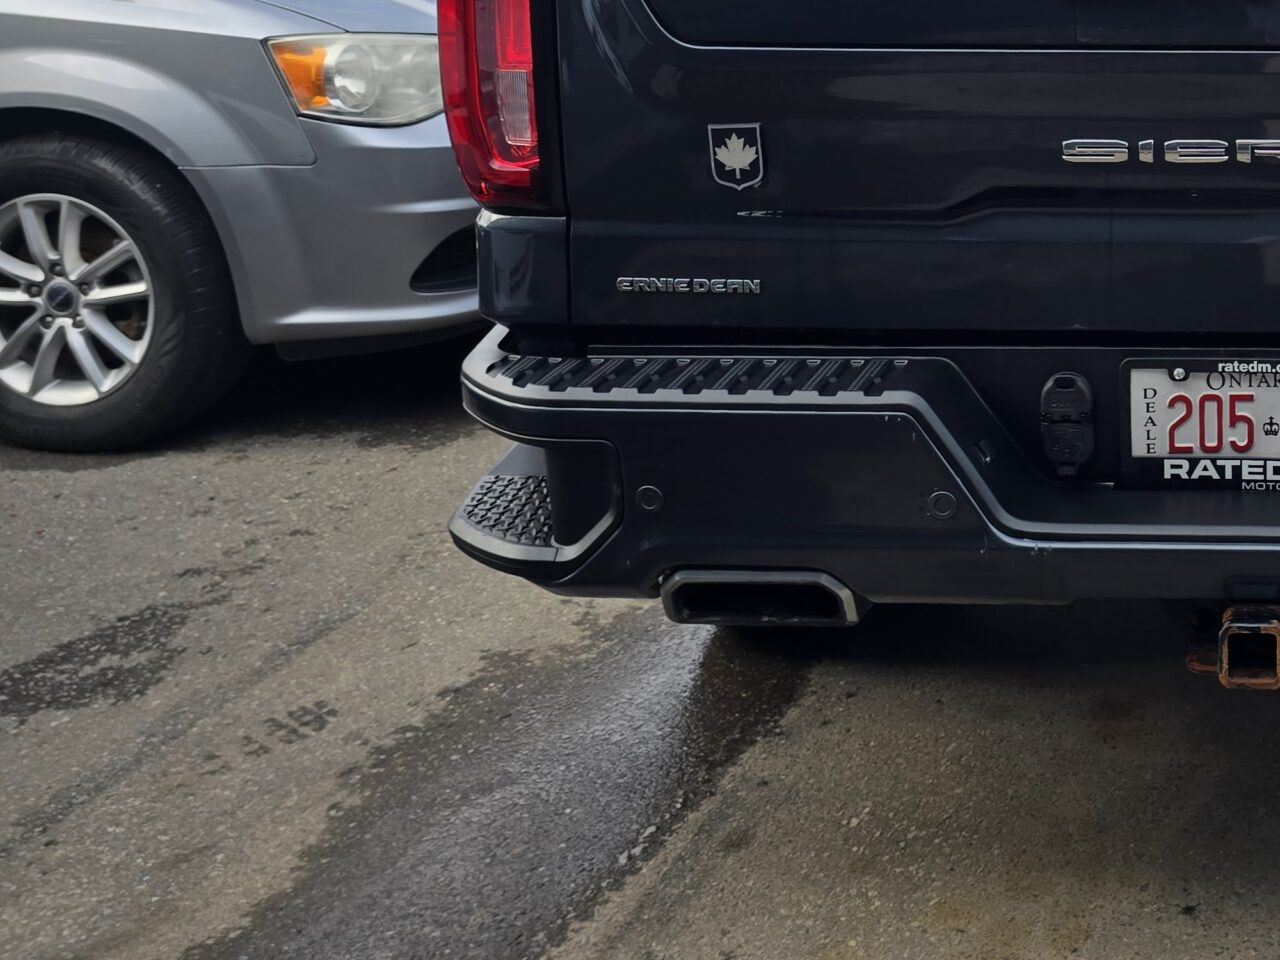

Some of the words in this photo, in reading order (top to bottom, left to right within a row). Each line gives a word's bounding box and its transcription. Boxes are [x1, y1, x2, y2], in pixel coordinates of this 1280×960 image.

[616, 277, 690, 293] ERNIE
[693, 278, 761, 294] DEAN
[1143, 388, 1157, 455] DEALE
[1167, 393, 1256, 454] 205
